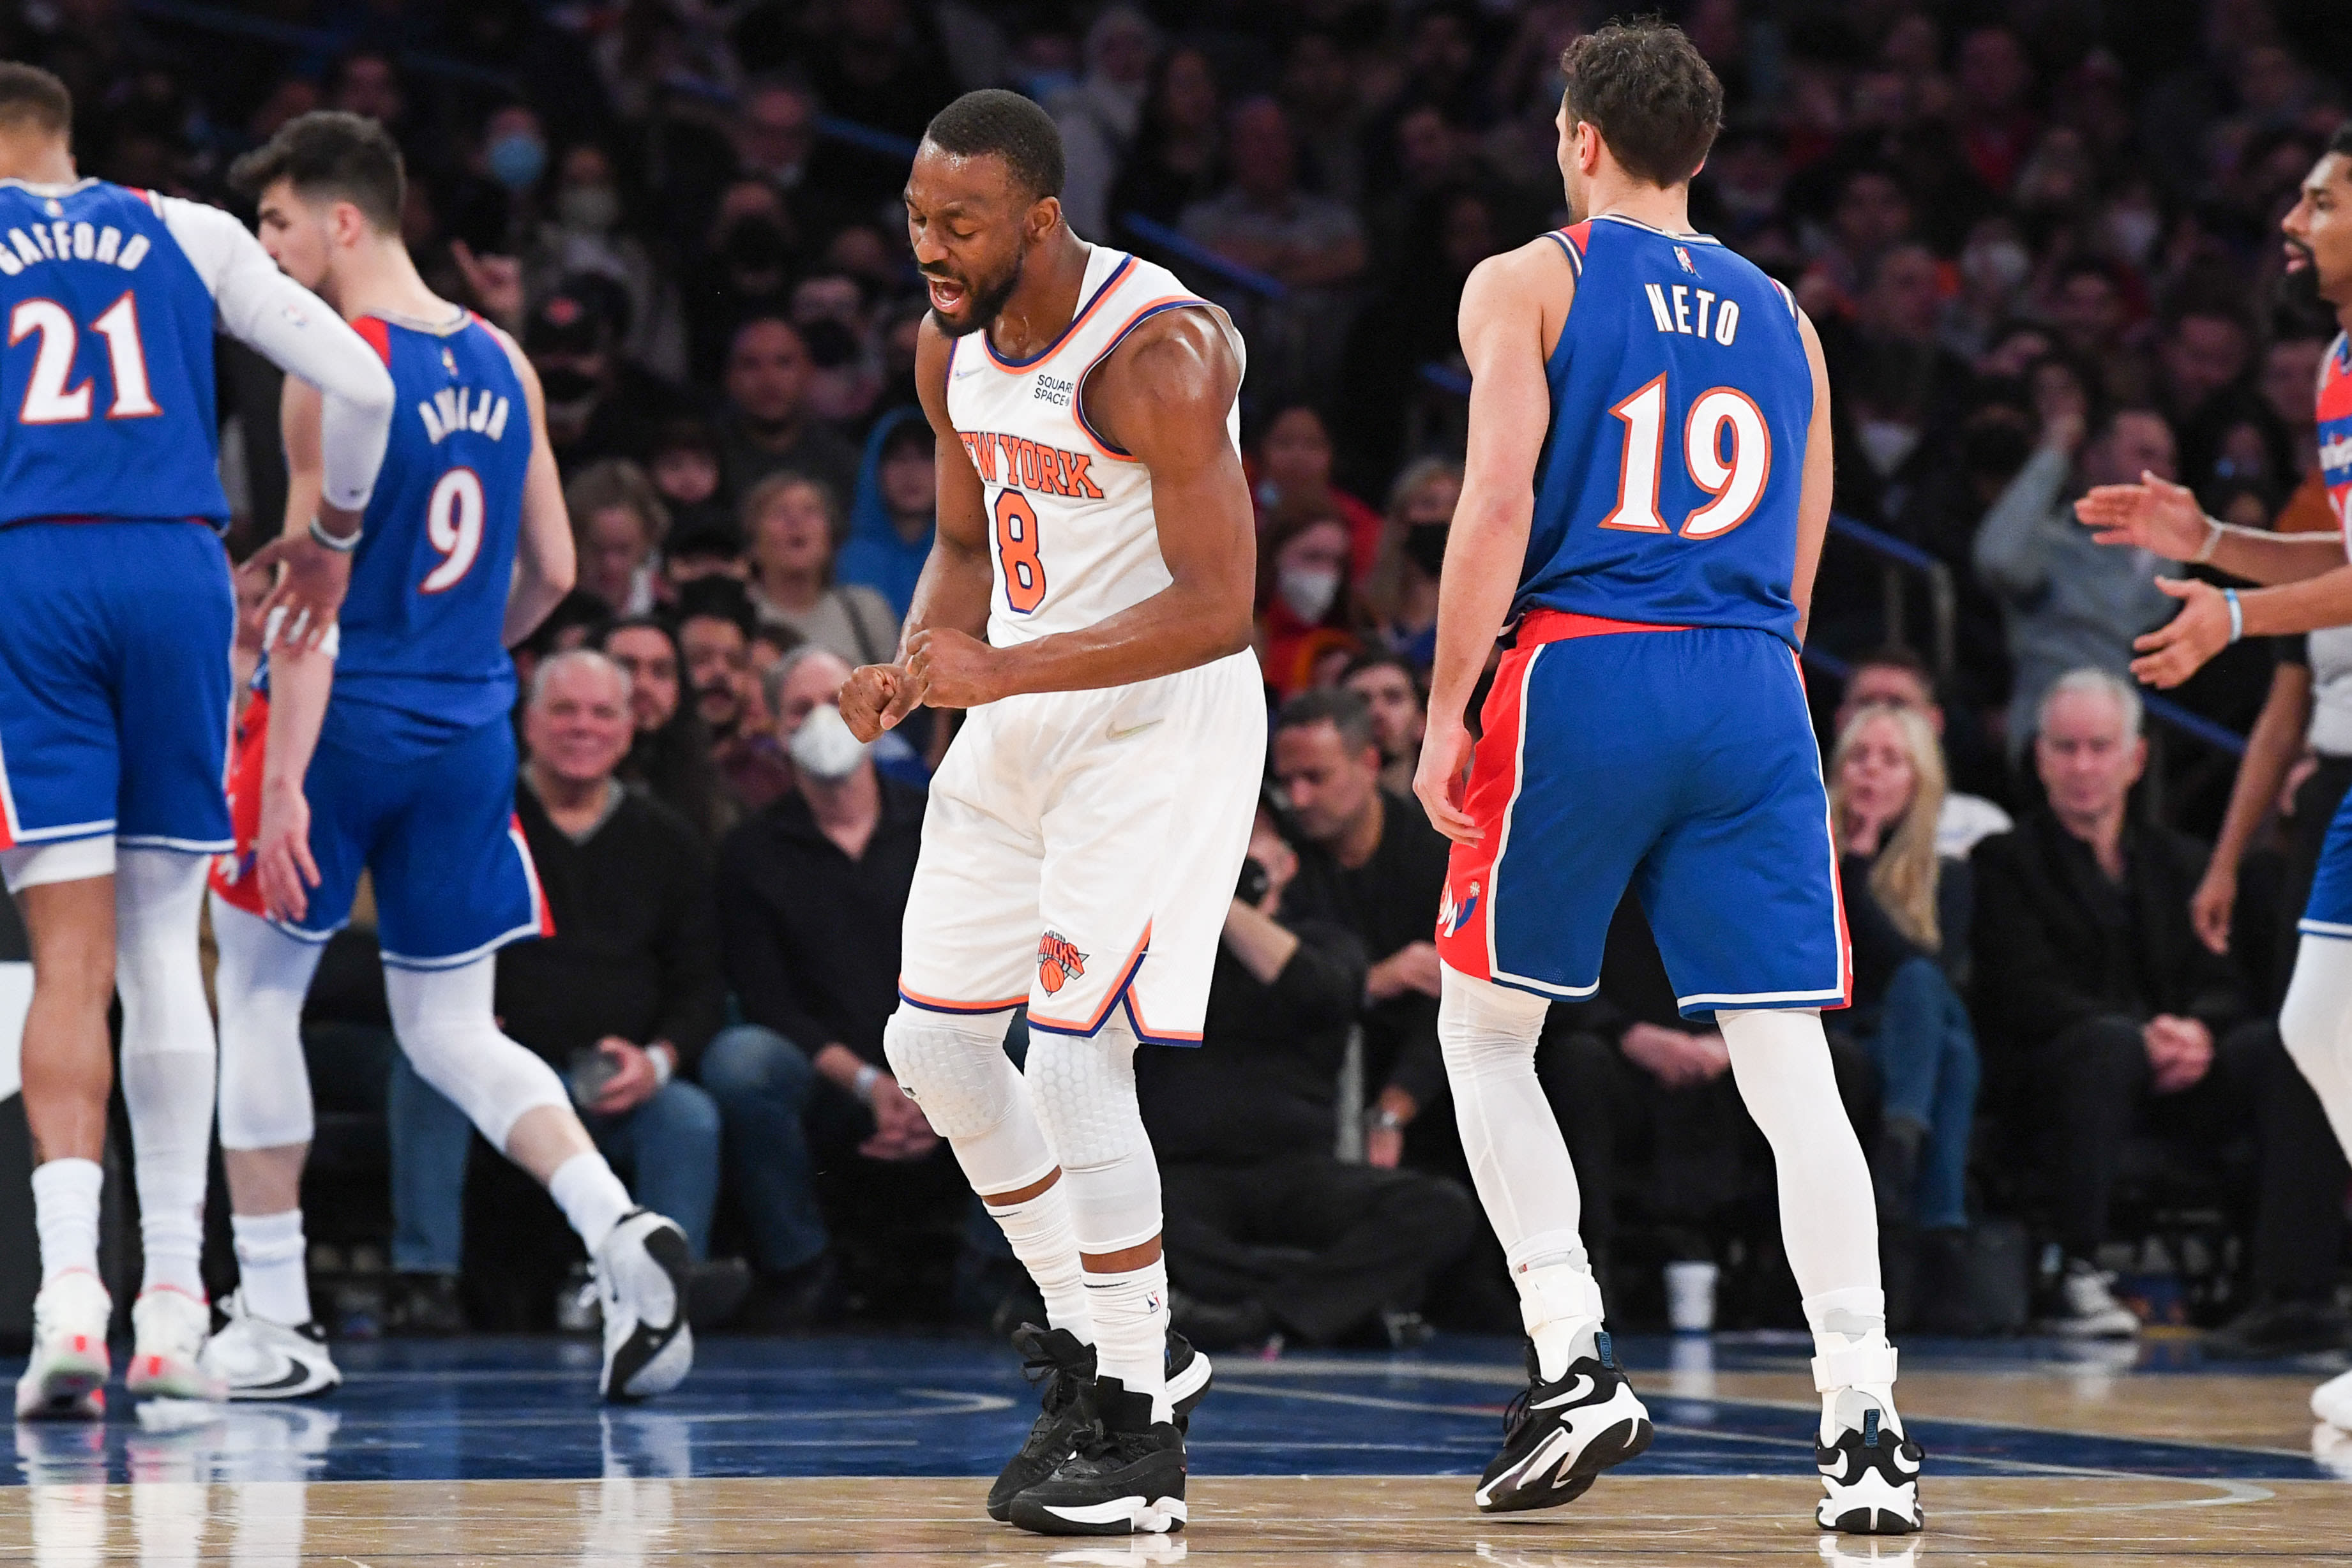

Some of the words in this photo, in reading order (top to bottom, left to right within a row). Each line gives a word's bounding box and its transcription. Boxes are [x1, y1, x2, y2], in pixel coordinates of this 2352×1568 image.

[8, 289, 164, 425] 21
[1644, 283, 1740, 346] NETO
[1034, 388, 1066, 406] SPACE
[1597, 370, 1772, 540] 19
[999, 433, 1108, 499] YORK
[416, 465, 485, 595] 9
[994, 488, 1046, 615] 8
